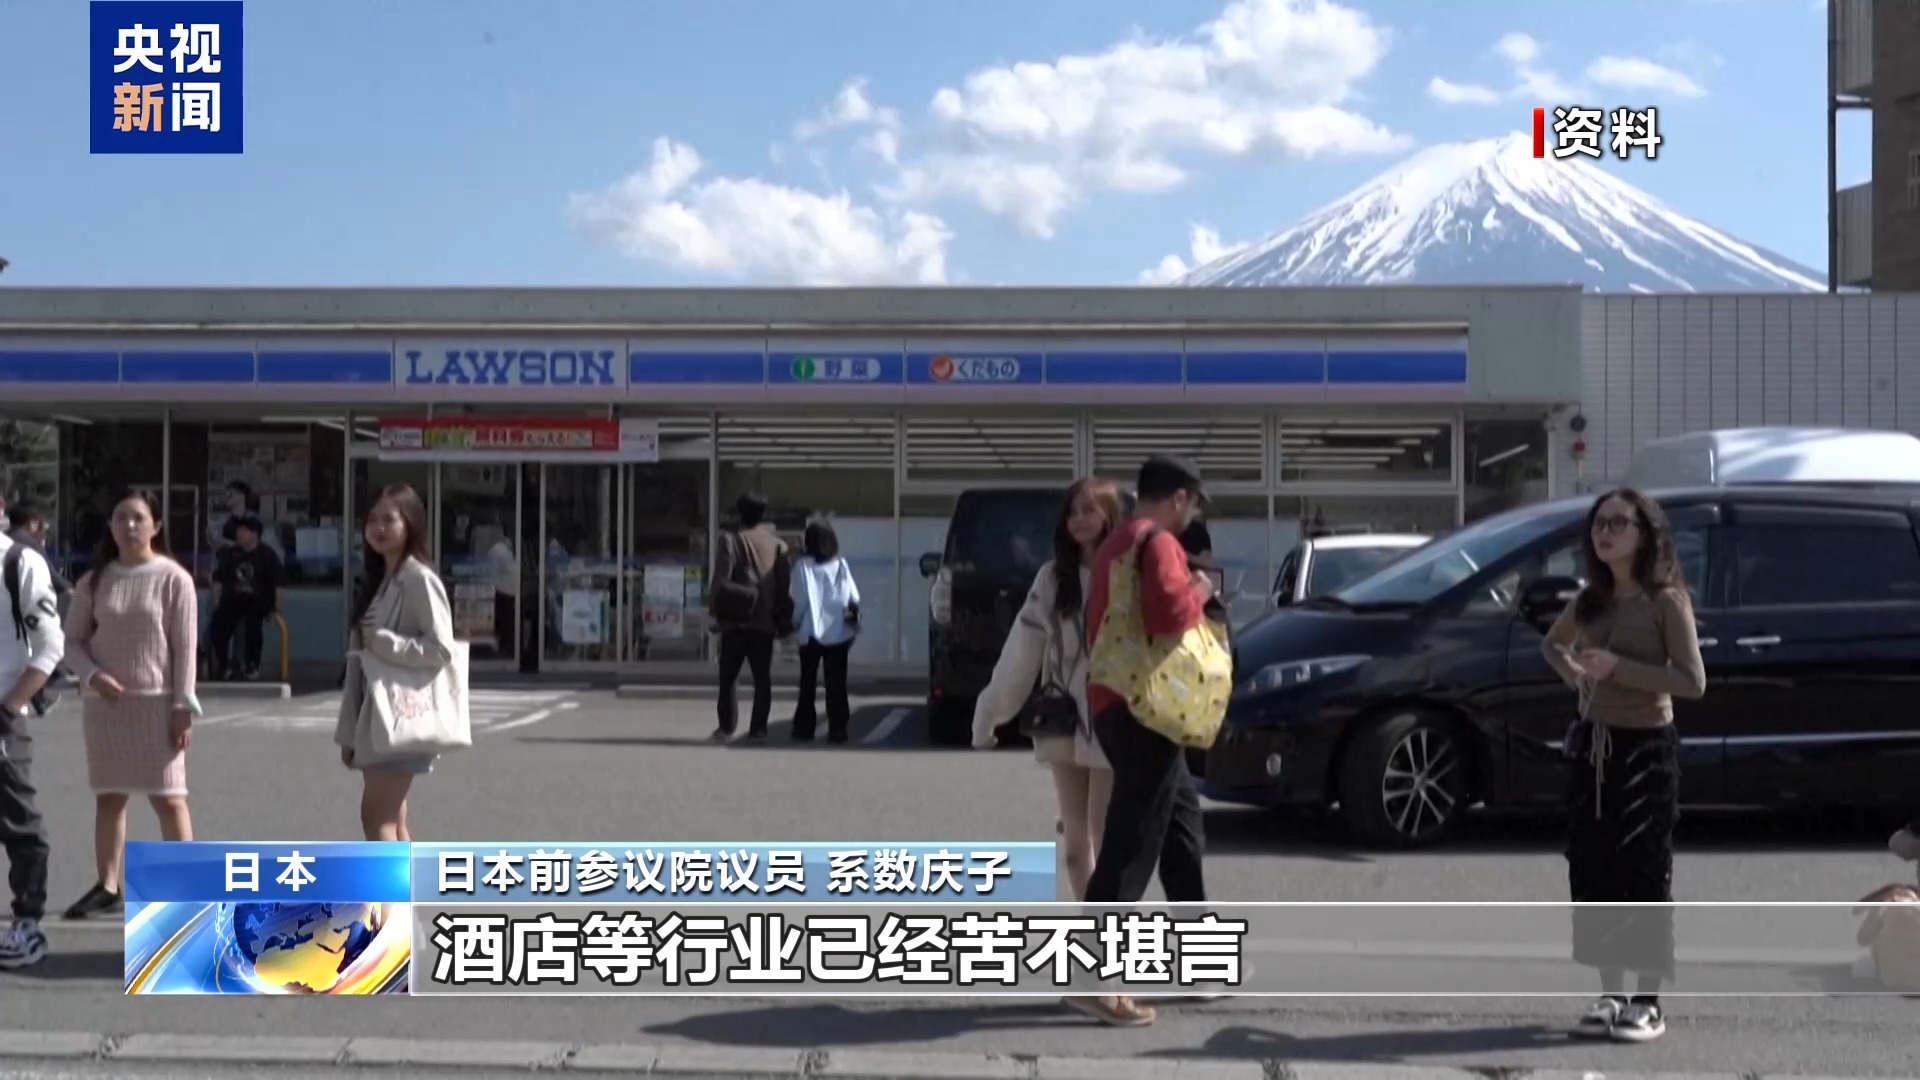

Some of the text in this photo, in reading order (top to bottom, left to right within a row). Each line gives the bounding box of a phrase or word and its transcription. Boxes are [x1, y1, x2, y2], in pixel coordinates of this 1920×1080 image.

[405, 350, 615, 385] LAWSON
[957, 358, 1016, 378] くだもの
